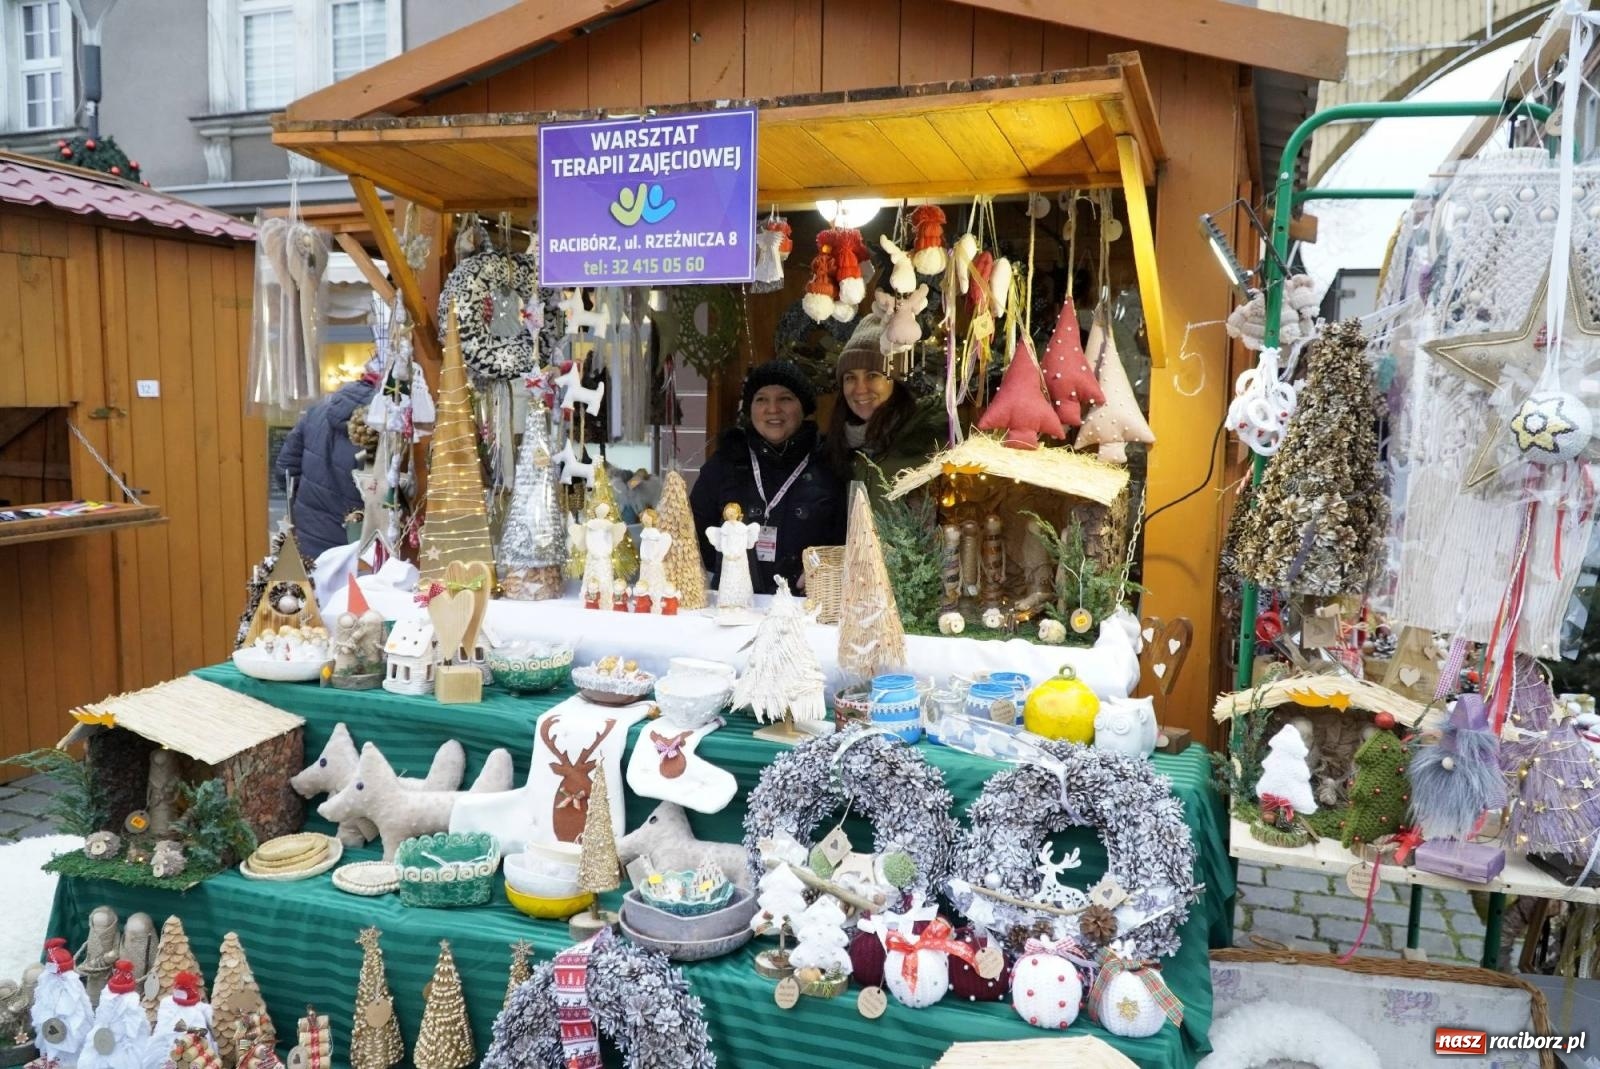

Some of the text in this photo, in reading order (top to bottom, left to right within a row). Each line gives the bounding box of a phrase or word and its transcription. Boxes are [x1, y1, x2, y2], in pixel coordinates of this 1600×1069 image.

[591, 124, 699, 151] WARSZTAT
[551, 146, 741, 177] TERAPII ZAJĘCIOWEJ
[549, 230, 738, 253] RACIBÓRZ, ul. RZEŹNICZA 8
[583, 256, 705, 276] tel: 32 415 05 60
